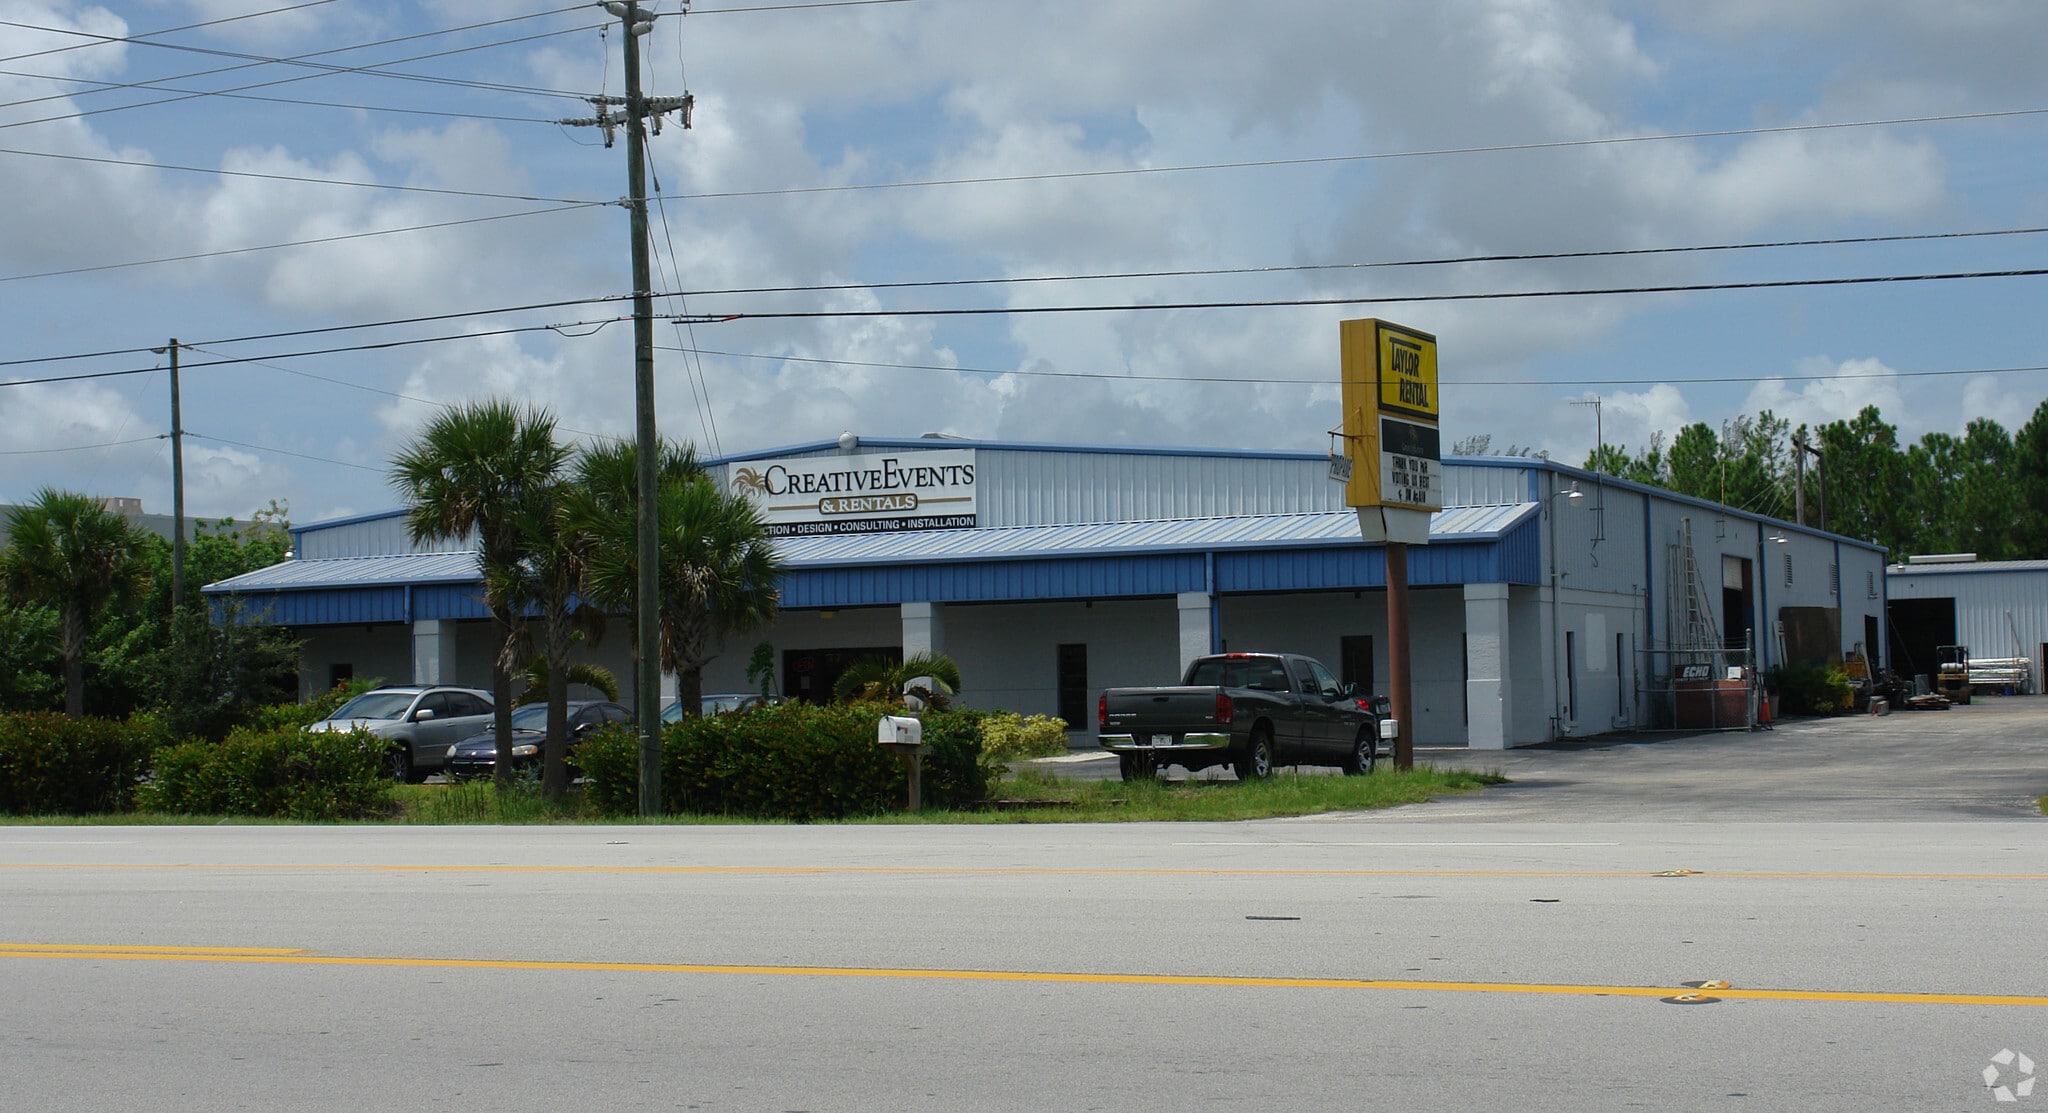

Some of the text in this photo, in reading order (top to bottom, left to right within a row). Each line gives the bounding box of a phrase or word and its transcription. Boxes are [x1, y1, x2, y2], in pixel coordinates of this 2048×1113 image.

[1389, 337, 1421, 377] TAYLOR
[1399, 378, 1428, 407] RENTAL
[821, 495, 915, 513] & RENTALS
[797, 522, 832, 534] DESIGN
[839, 519, 900, 531] CONSULTING
[907, 516, 974, 528] INSTALLATION
[1682, 666, 1710, 678] ECHO
